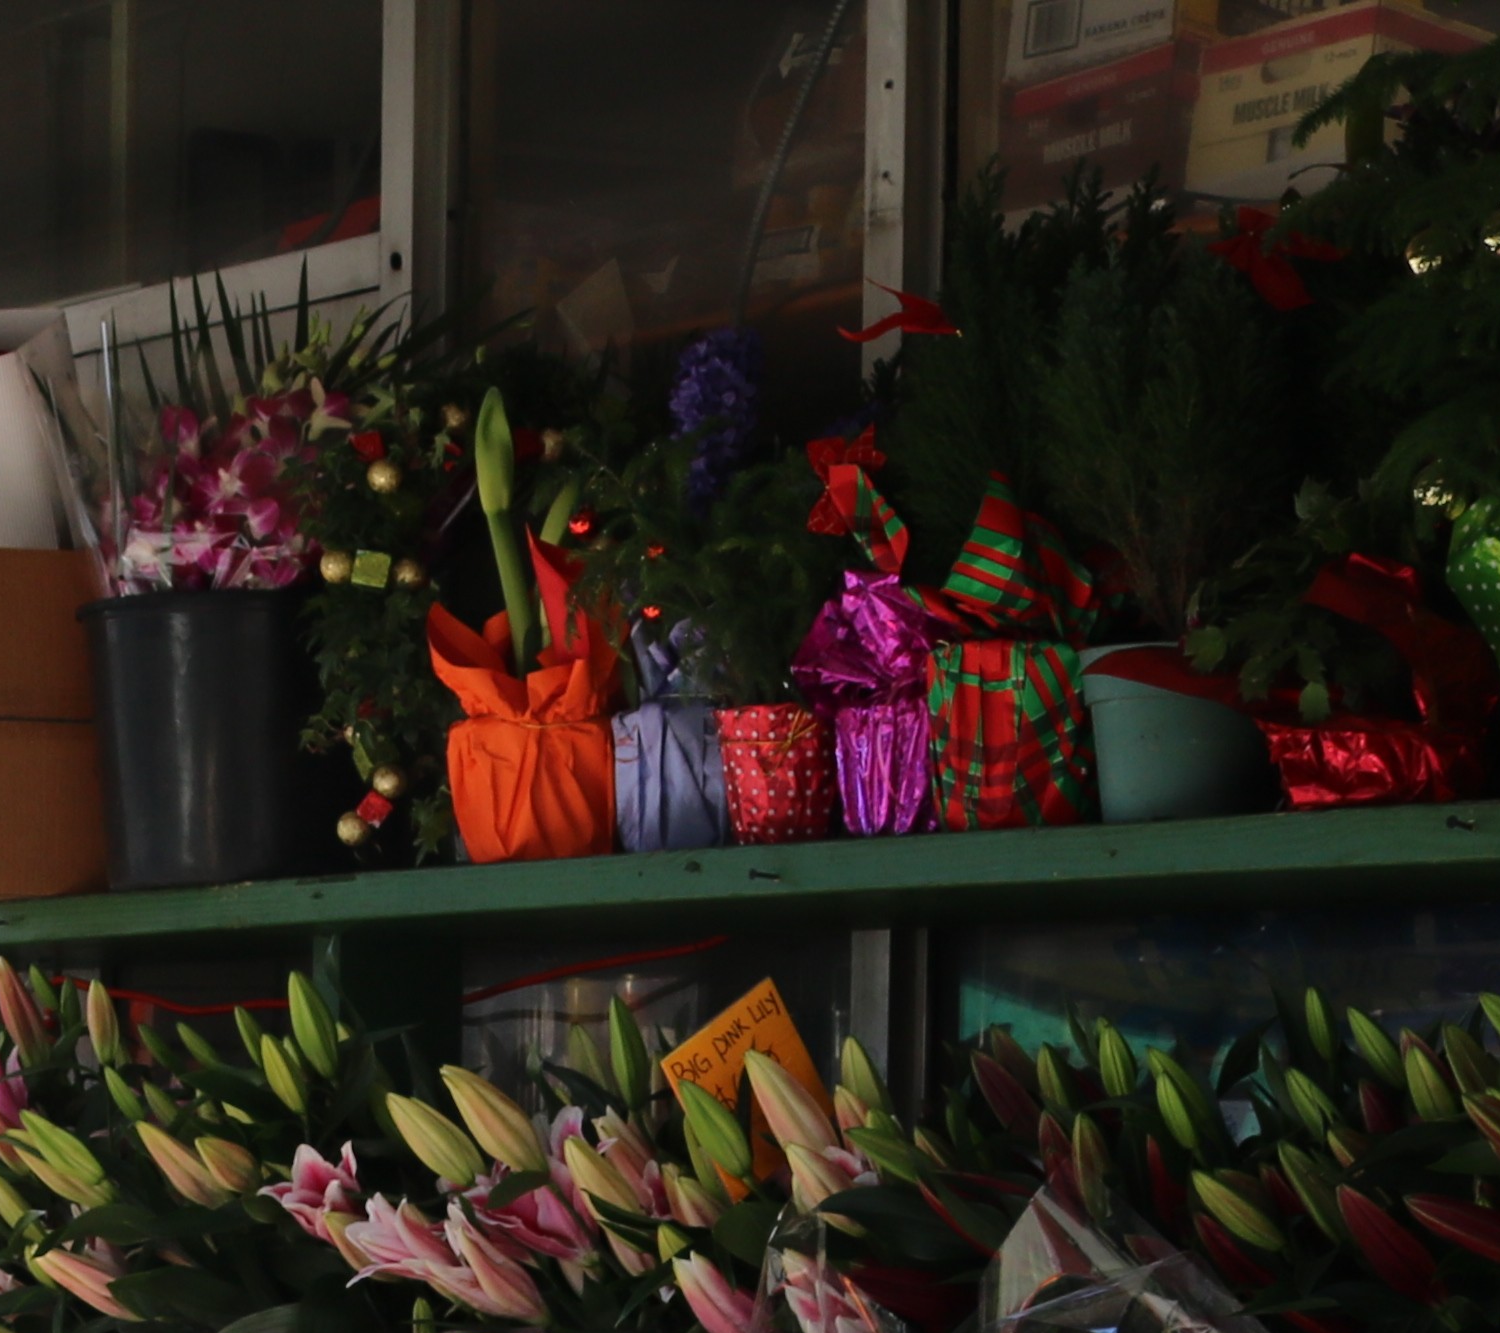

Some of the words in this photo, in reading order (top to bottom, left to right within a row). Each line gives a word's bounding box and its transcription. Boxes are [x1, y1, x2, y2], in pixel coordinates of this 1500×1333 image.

[671, 1052, 713, 1083] BIG
[711, 1017, 752, 1064] PINK
[747, 990, 782, 1024] LILY
